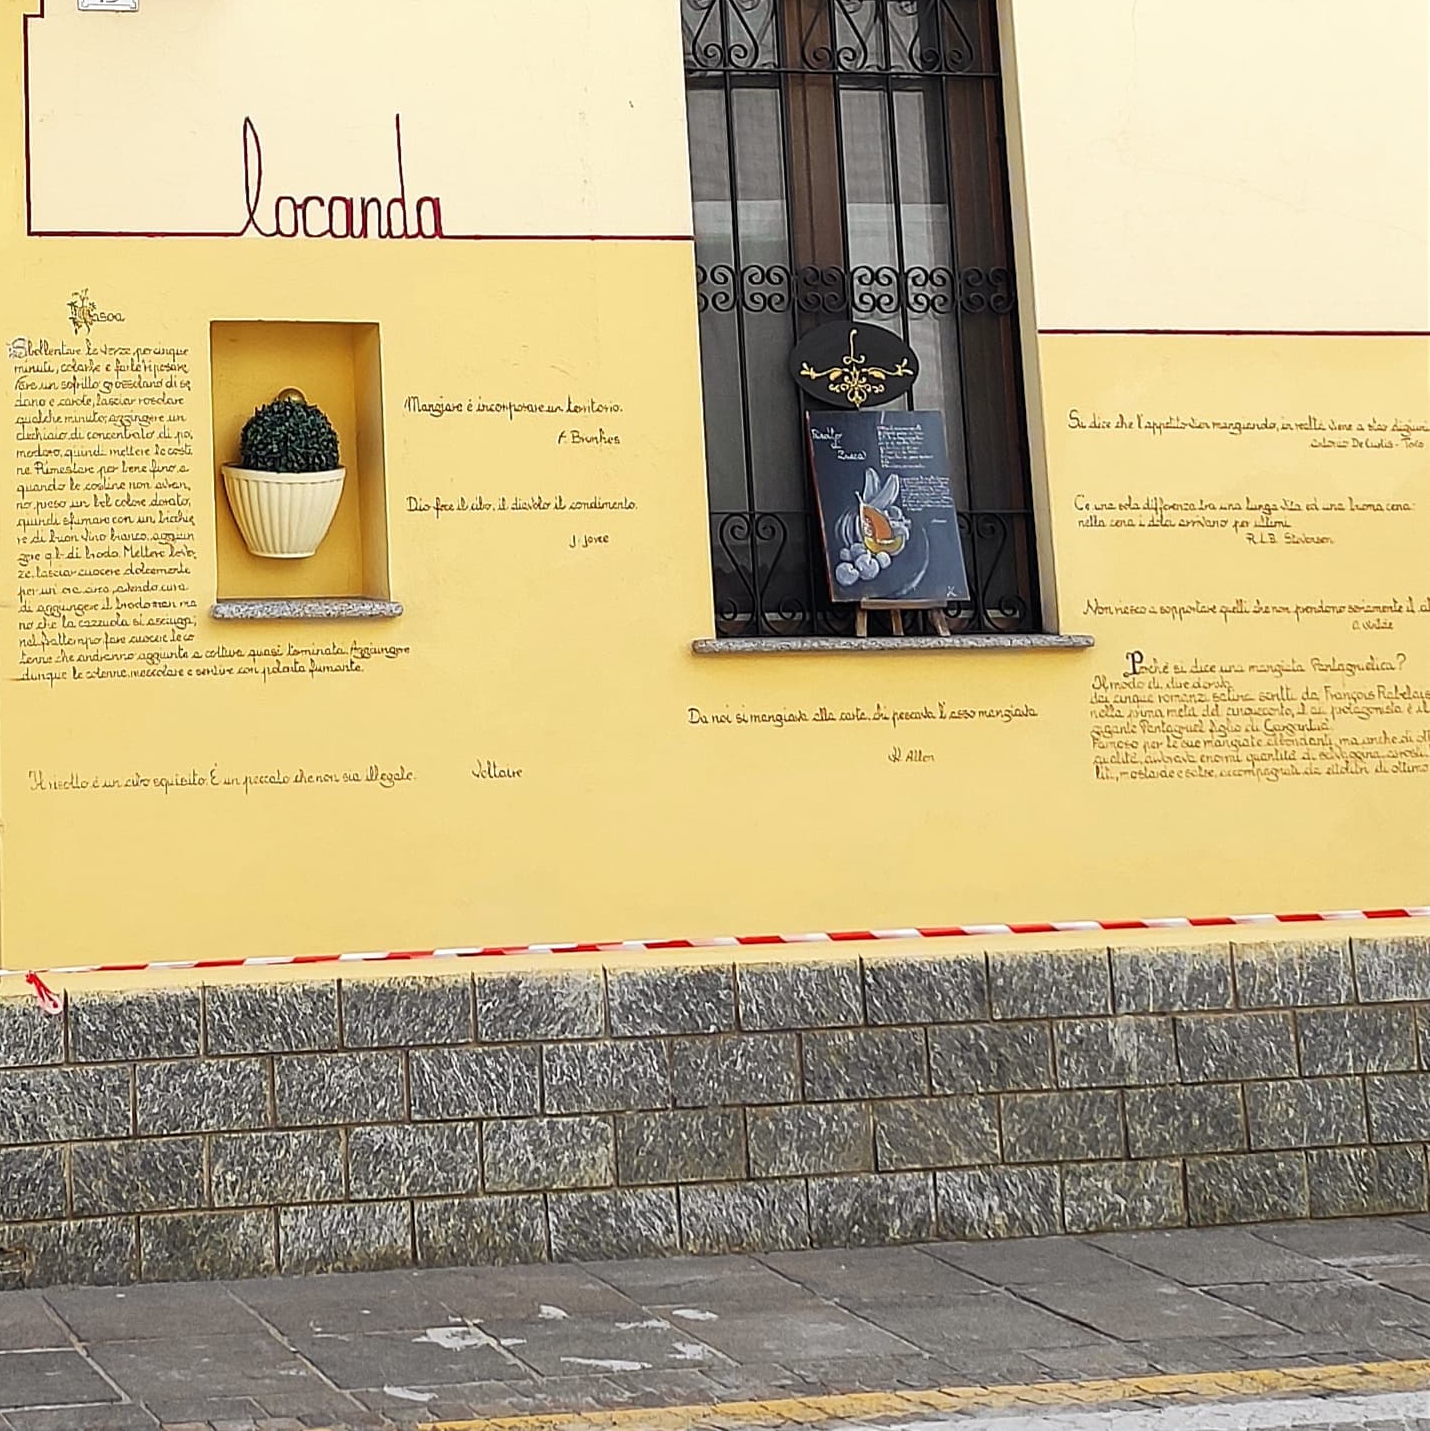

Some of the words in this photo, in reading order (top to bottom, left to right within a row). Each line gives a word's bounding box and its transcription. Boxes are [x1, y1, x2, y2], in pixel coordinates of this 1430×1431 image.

[241, 113, 444, 239] locanda
[404, 396, 463, 418] Mangiare
[406, 496, 431, 512] Dio
